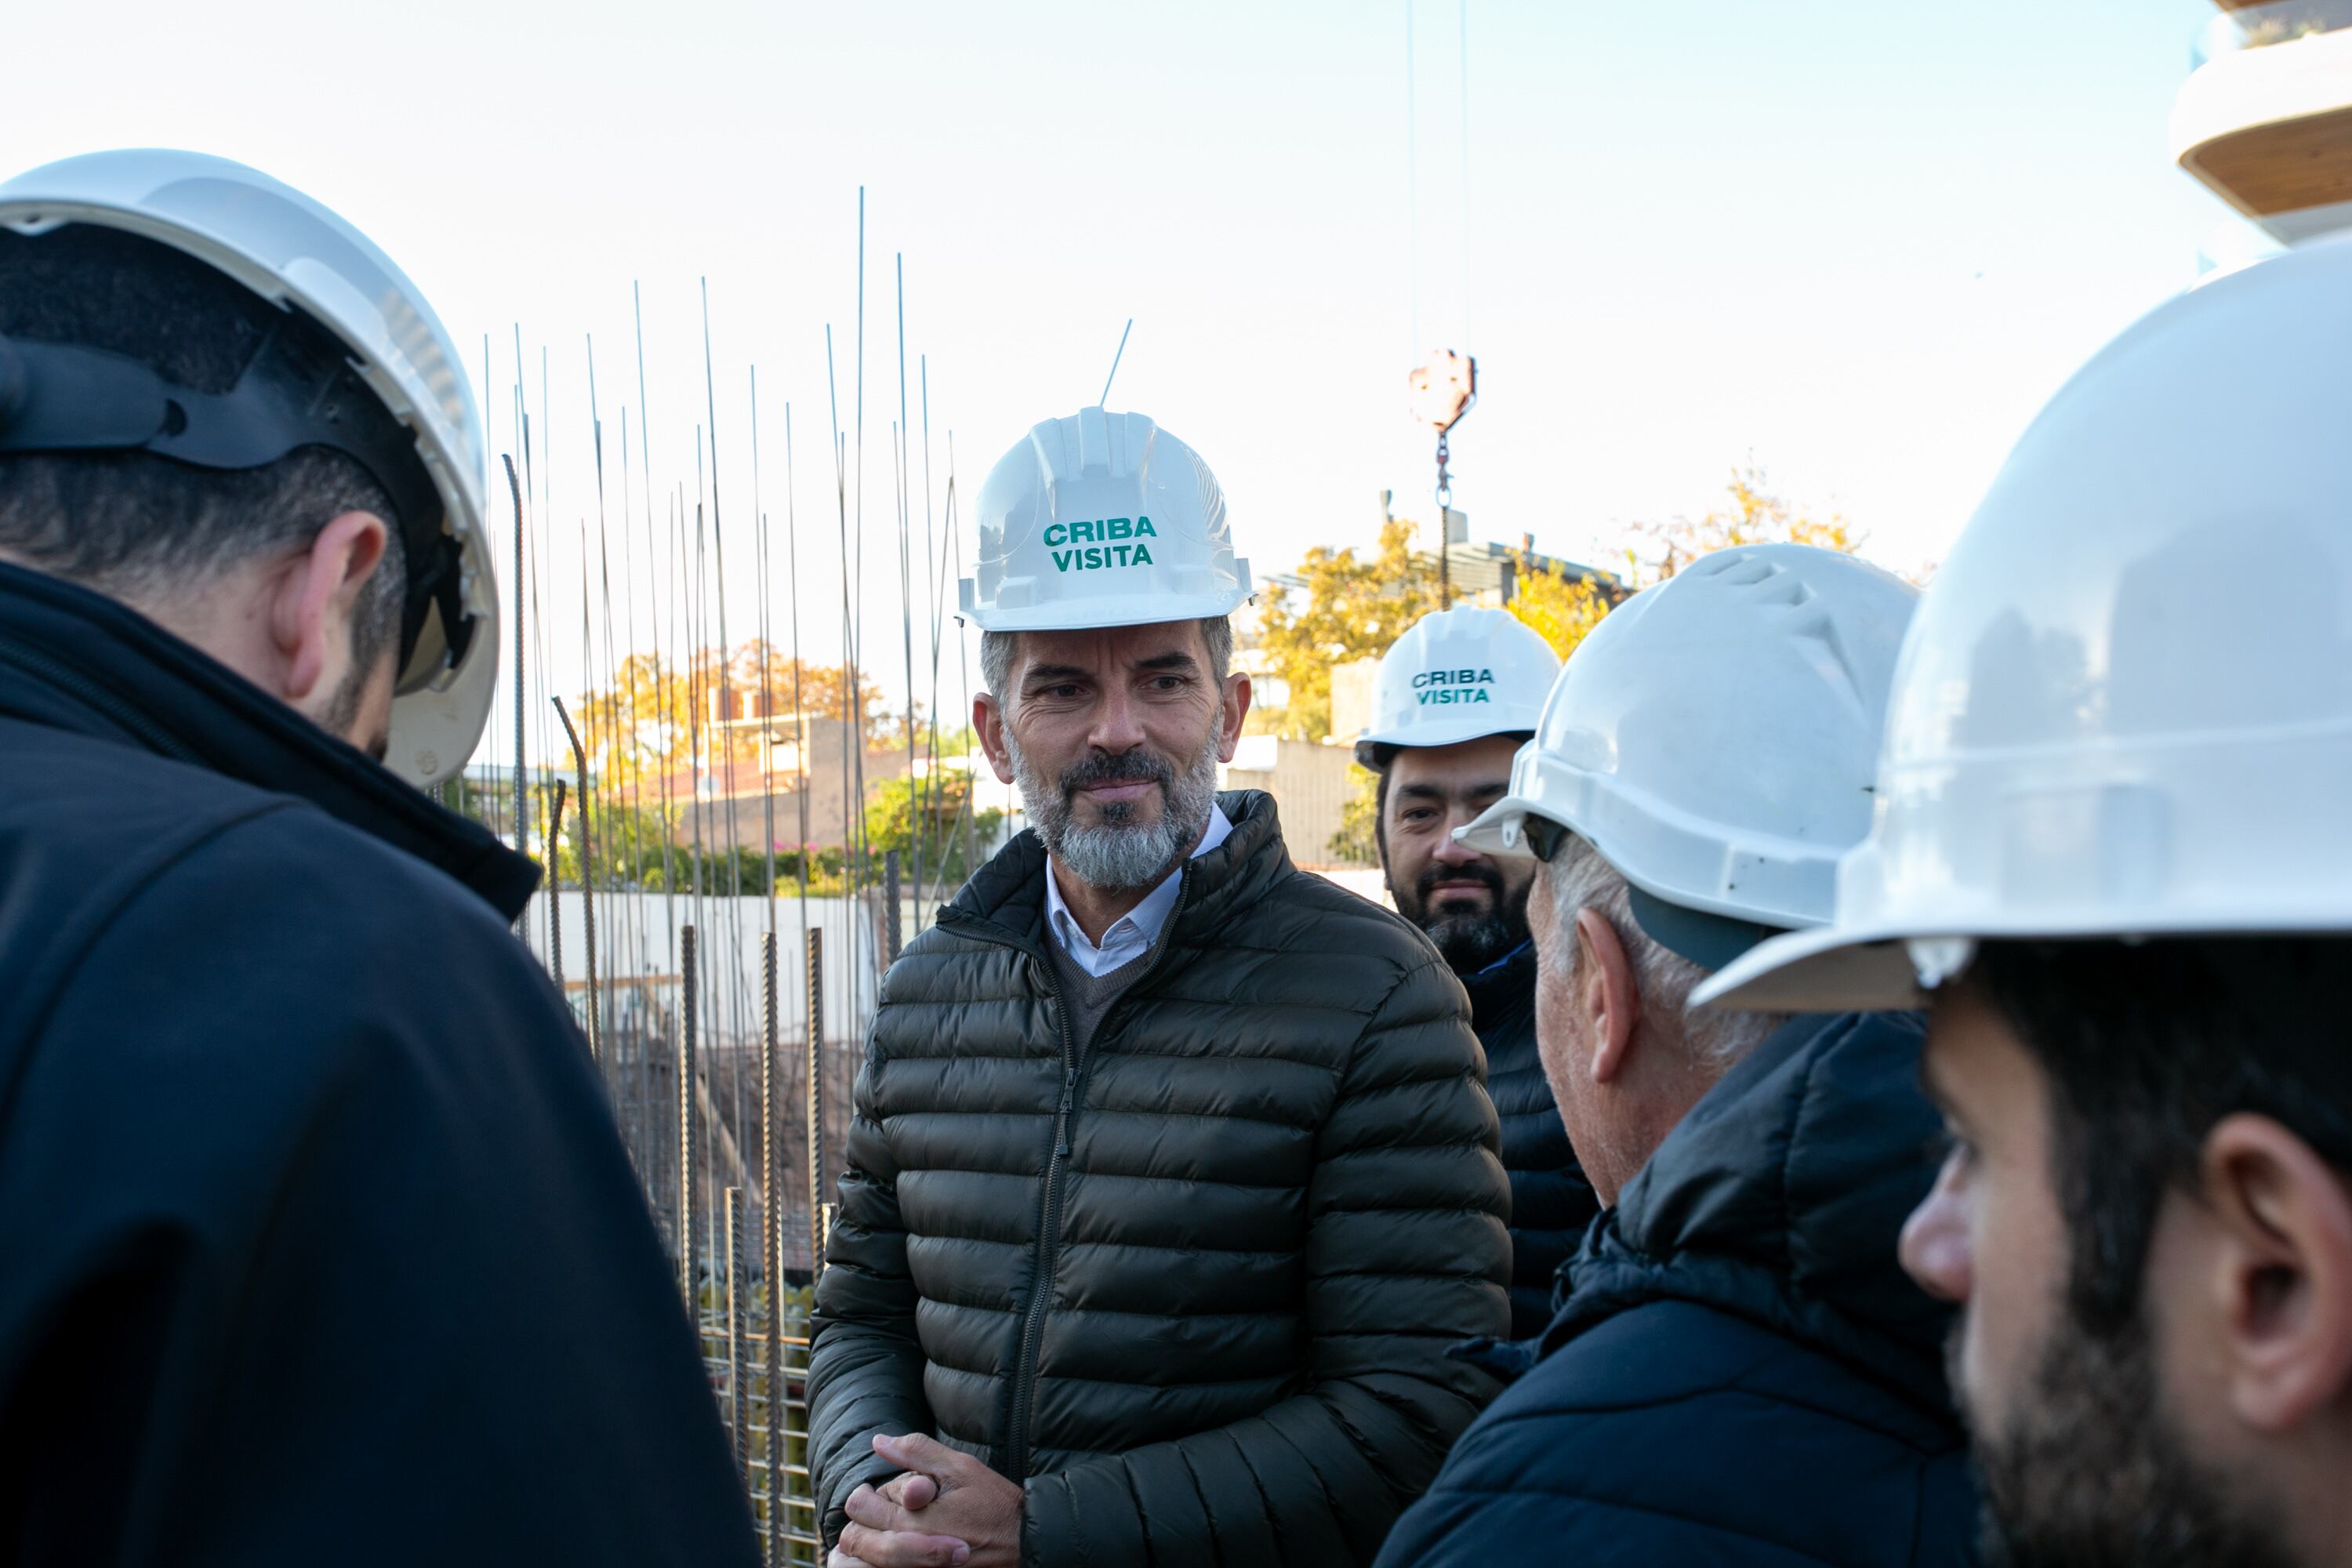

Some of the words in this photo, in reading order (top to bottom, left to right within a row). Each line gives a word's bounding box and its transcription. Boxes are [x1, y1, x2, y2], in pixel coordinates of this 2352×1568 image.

[1044, 516, 1157, 546] CRIBA
[1051, 543, 1153, 572] VISITA
[1412, 669, 1495, 688] CRIBA
[1416, 688, 1490, 705] VISITA
